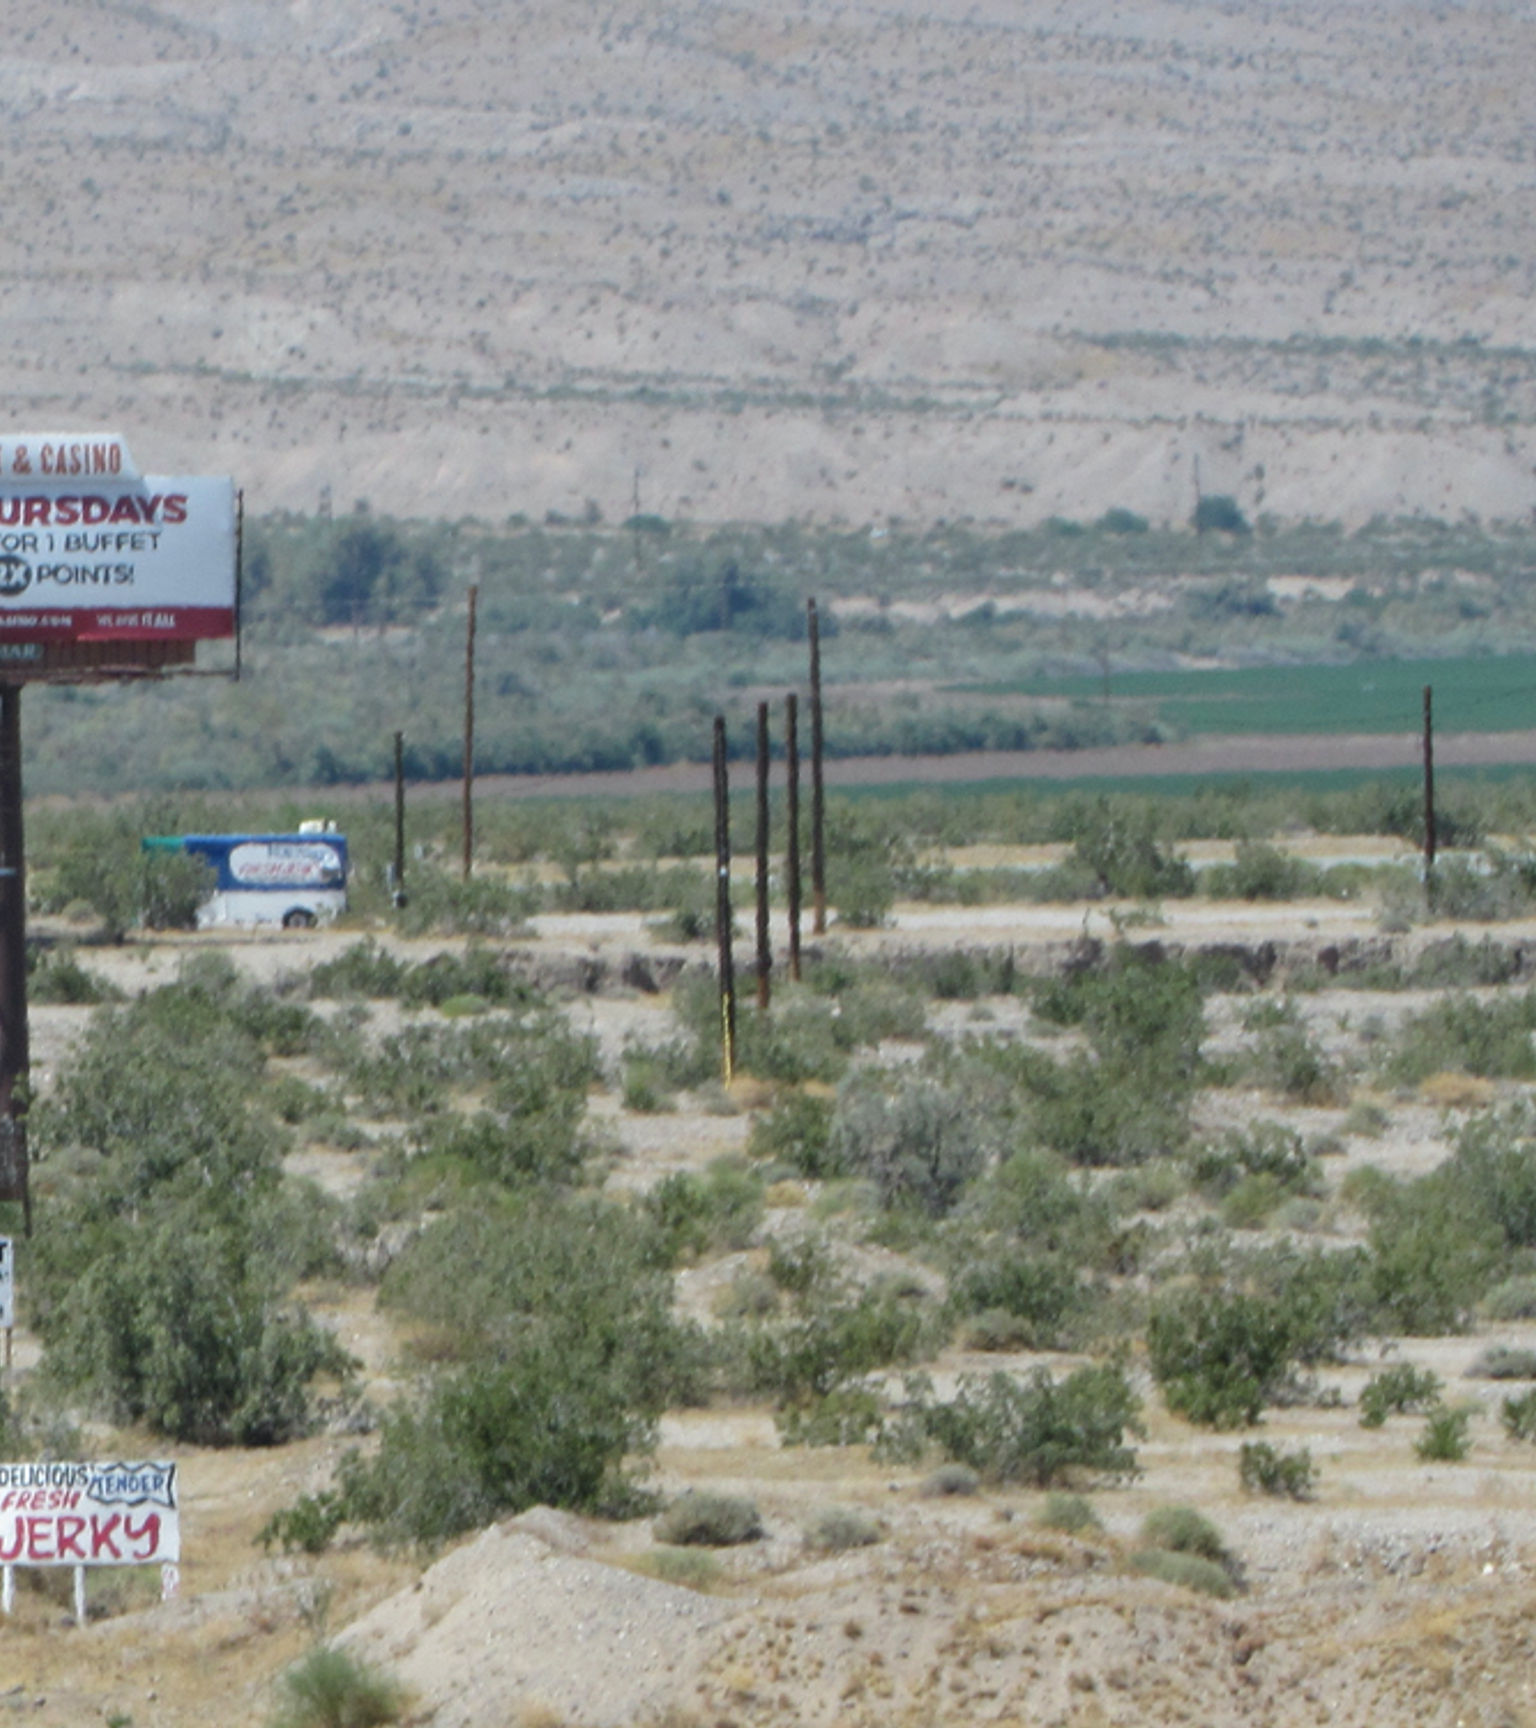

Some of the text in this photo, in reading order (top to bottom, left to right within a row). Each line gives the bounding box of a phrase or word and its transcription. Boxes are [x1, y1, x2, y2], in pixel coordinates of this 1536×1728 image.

[12, 446, 32, 475] &
[40, 443, 122, 476] CASINO
[46, 533, 54, 551] 1
[65, 531, 162, 552] BUFFET
[37, 562, 135, 585] POINTS!
[92, 1474, 164, 1494] TENDER
[0, 1490, 81, 1511] FRESH
